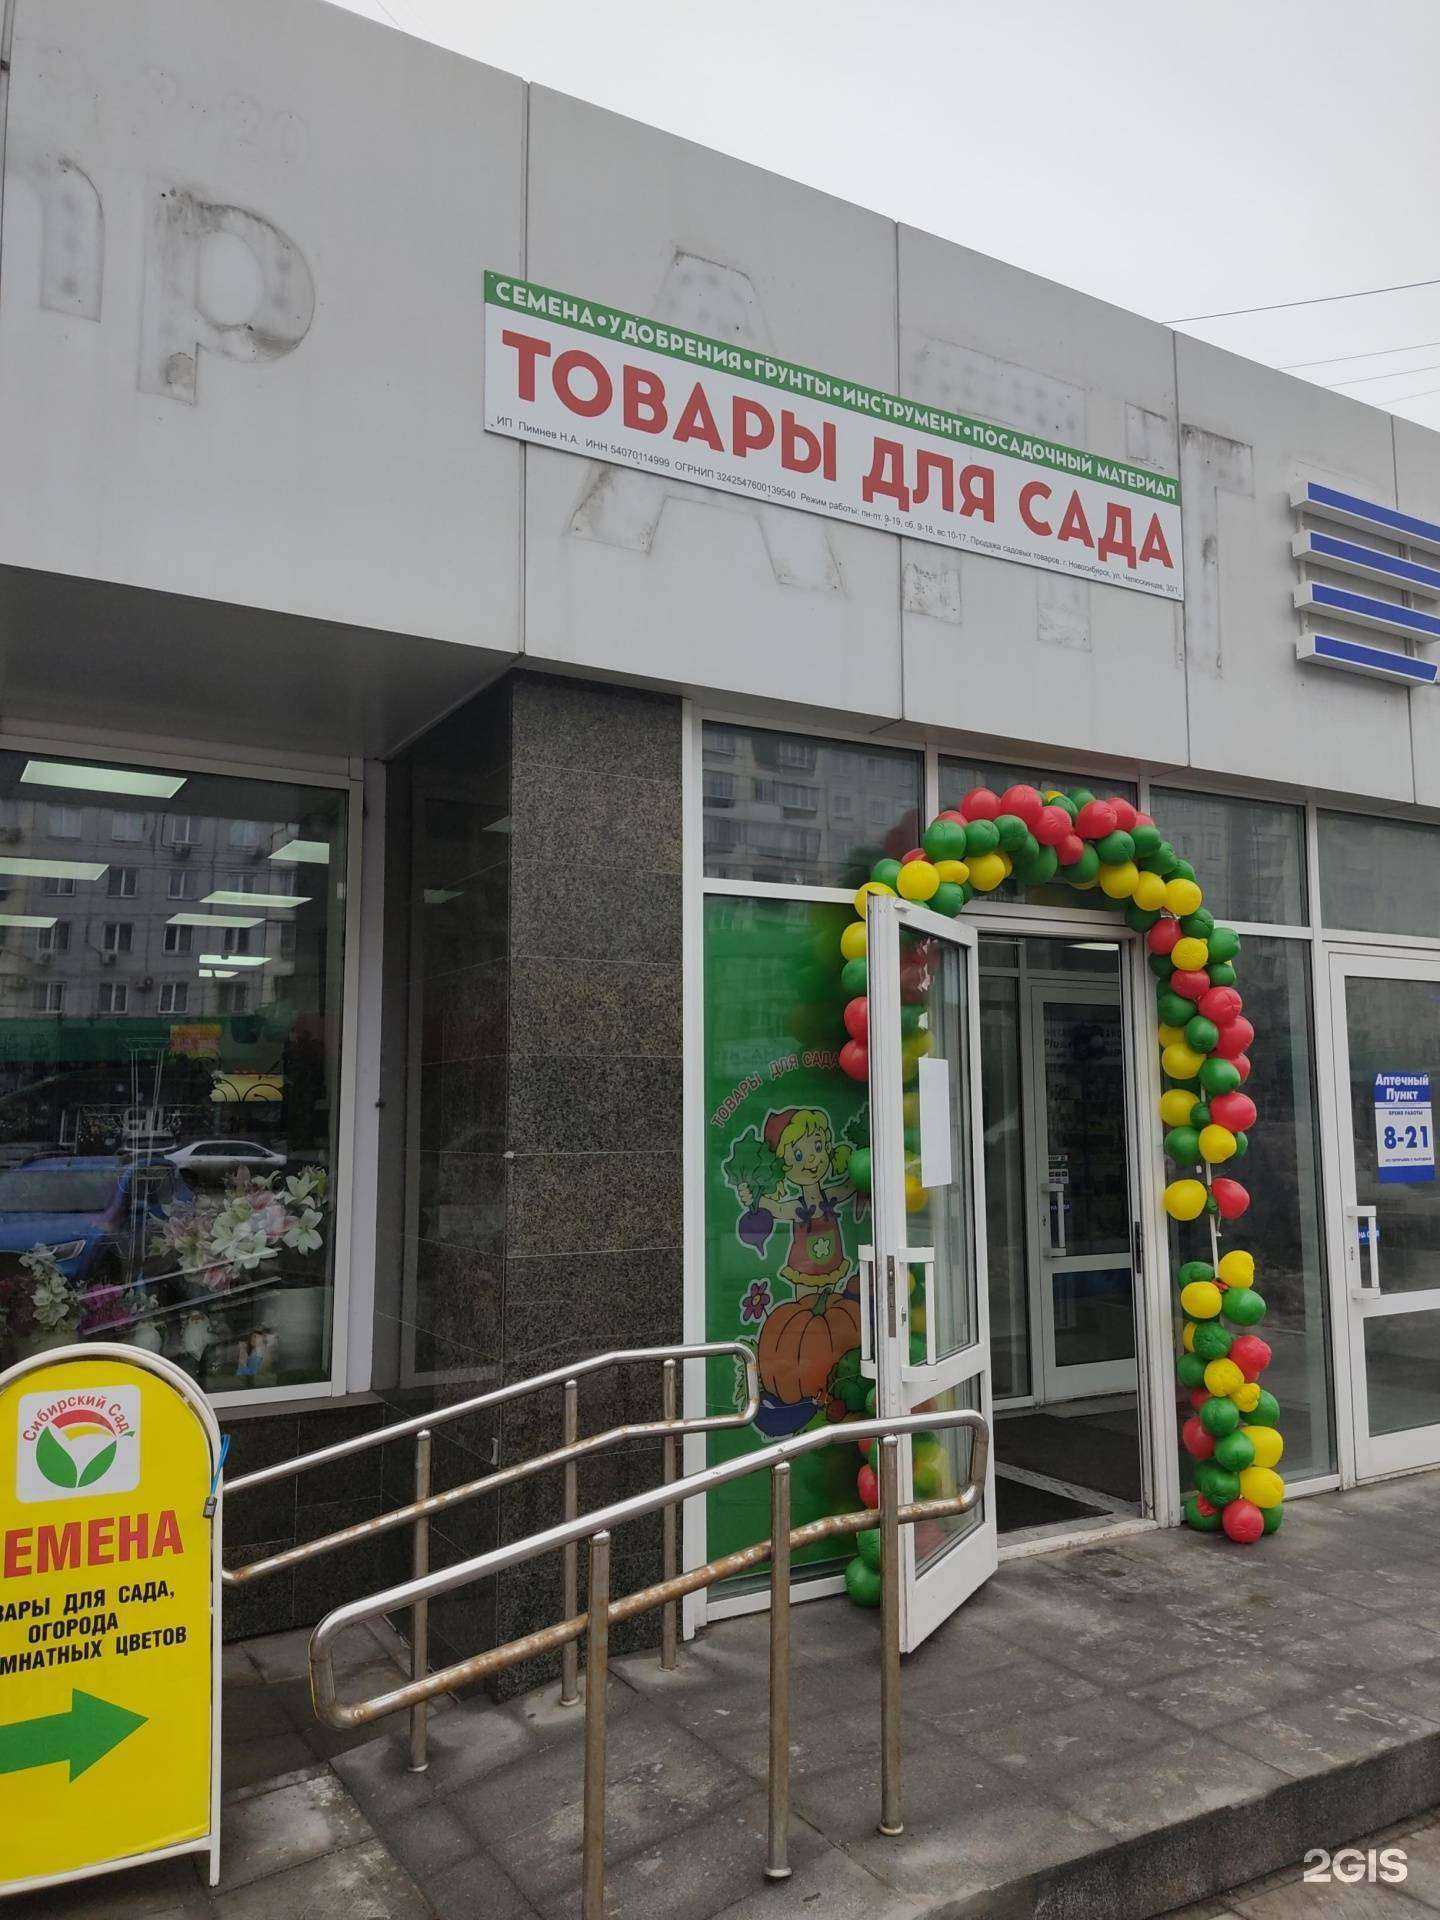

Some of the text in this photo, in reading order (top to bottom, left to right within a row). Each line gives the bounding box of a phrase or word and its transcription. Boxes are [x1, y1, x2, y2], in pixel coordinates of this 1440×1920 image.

[496, 282, 1177, 500] СЕМЕНА УДОБРЕНИЯ ГРУНТЫ ИНСТРУМЕНТ ПОСАДОЧНЫЙ МАТЕРИАЛ
[496, 416, 513, 428] ИП
[585, 438, 608, 452] ИНН
[610, 445, 670, 468] 54070114999
[674, 461, 714, 479] ОГРНИП
[502, 328, 1175, 570] ТОВАРЫ ДЛЯ САДА
[711, 1071, 763, 1128] ТОВАРЫ
[768, 1053, 799, 1081] ДЛЯ
[1375, 1073, 1429, 1086] Аптечный
[1386, 1087, 1418, 1101] Пункт
[1384, 1125, 1429, 1149] 8-21
[22, 1394, 131, 1442] Сибирский Сад
[3, 1509, 185, 1579] ЕМЕНА
[63, 1588, 106, 1616] ДЛЯ
[118, 1579, 176, 1605] САДА,
[28, 1611, 119, 1644] ОГОРОДА
[115, 1625, 187, 1656] ЦВЕТОВ
